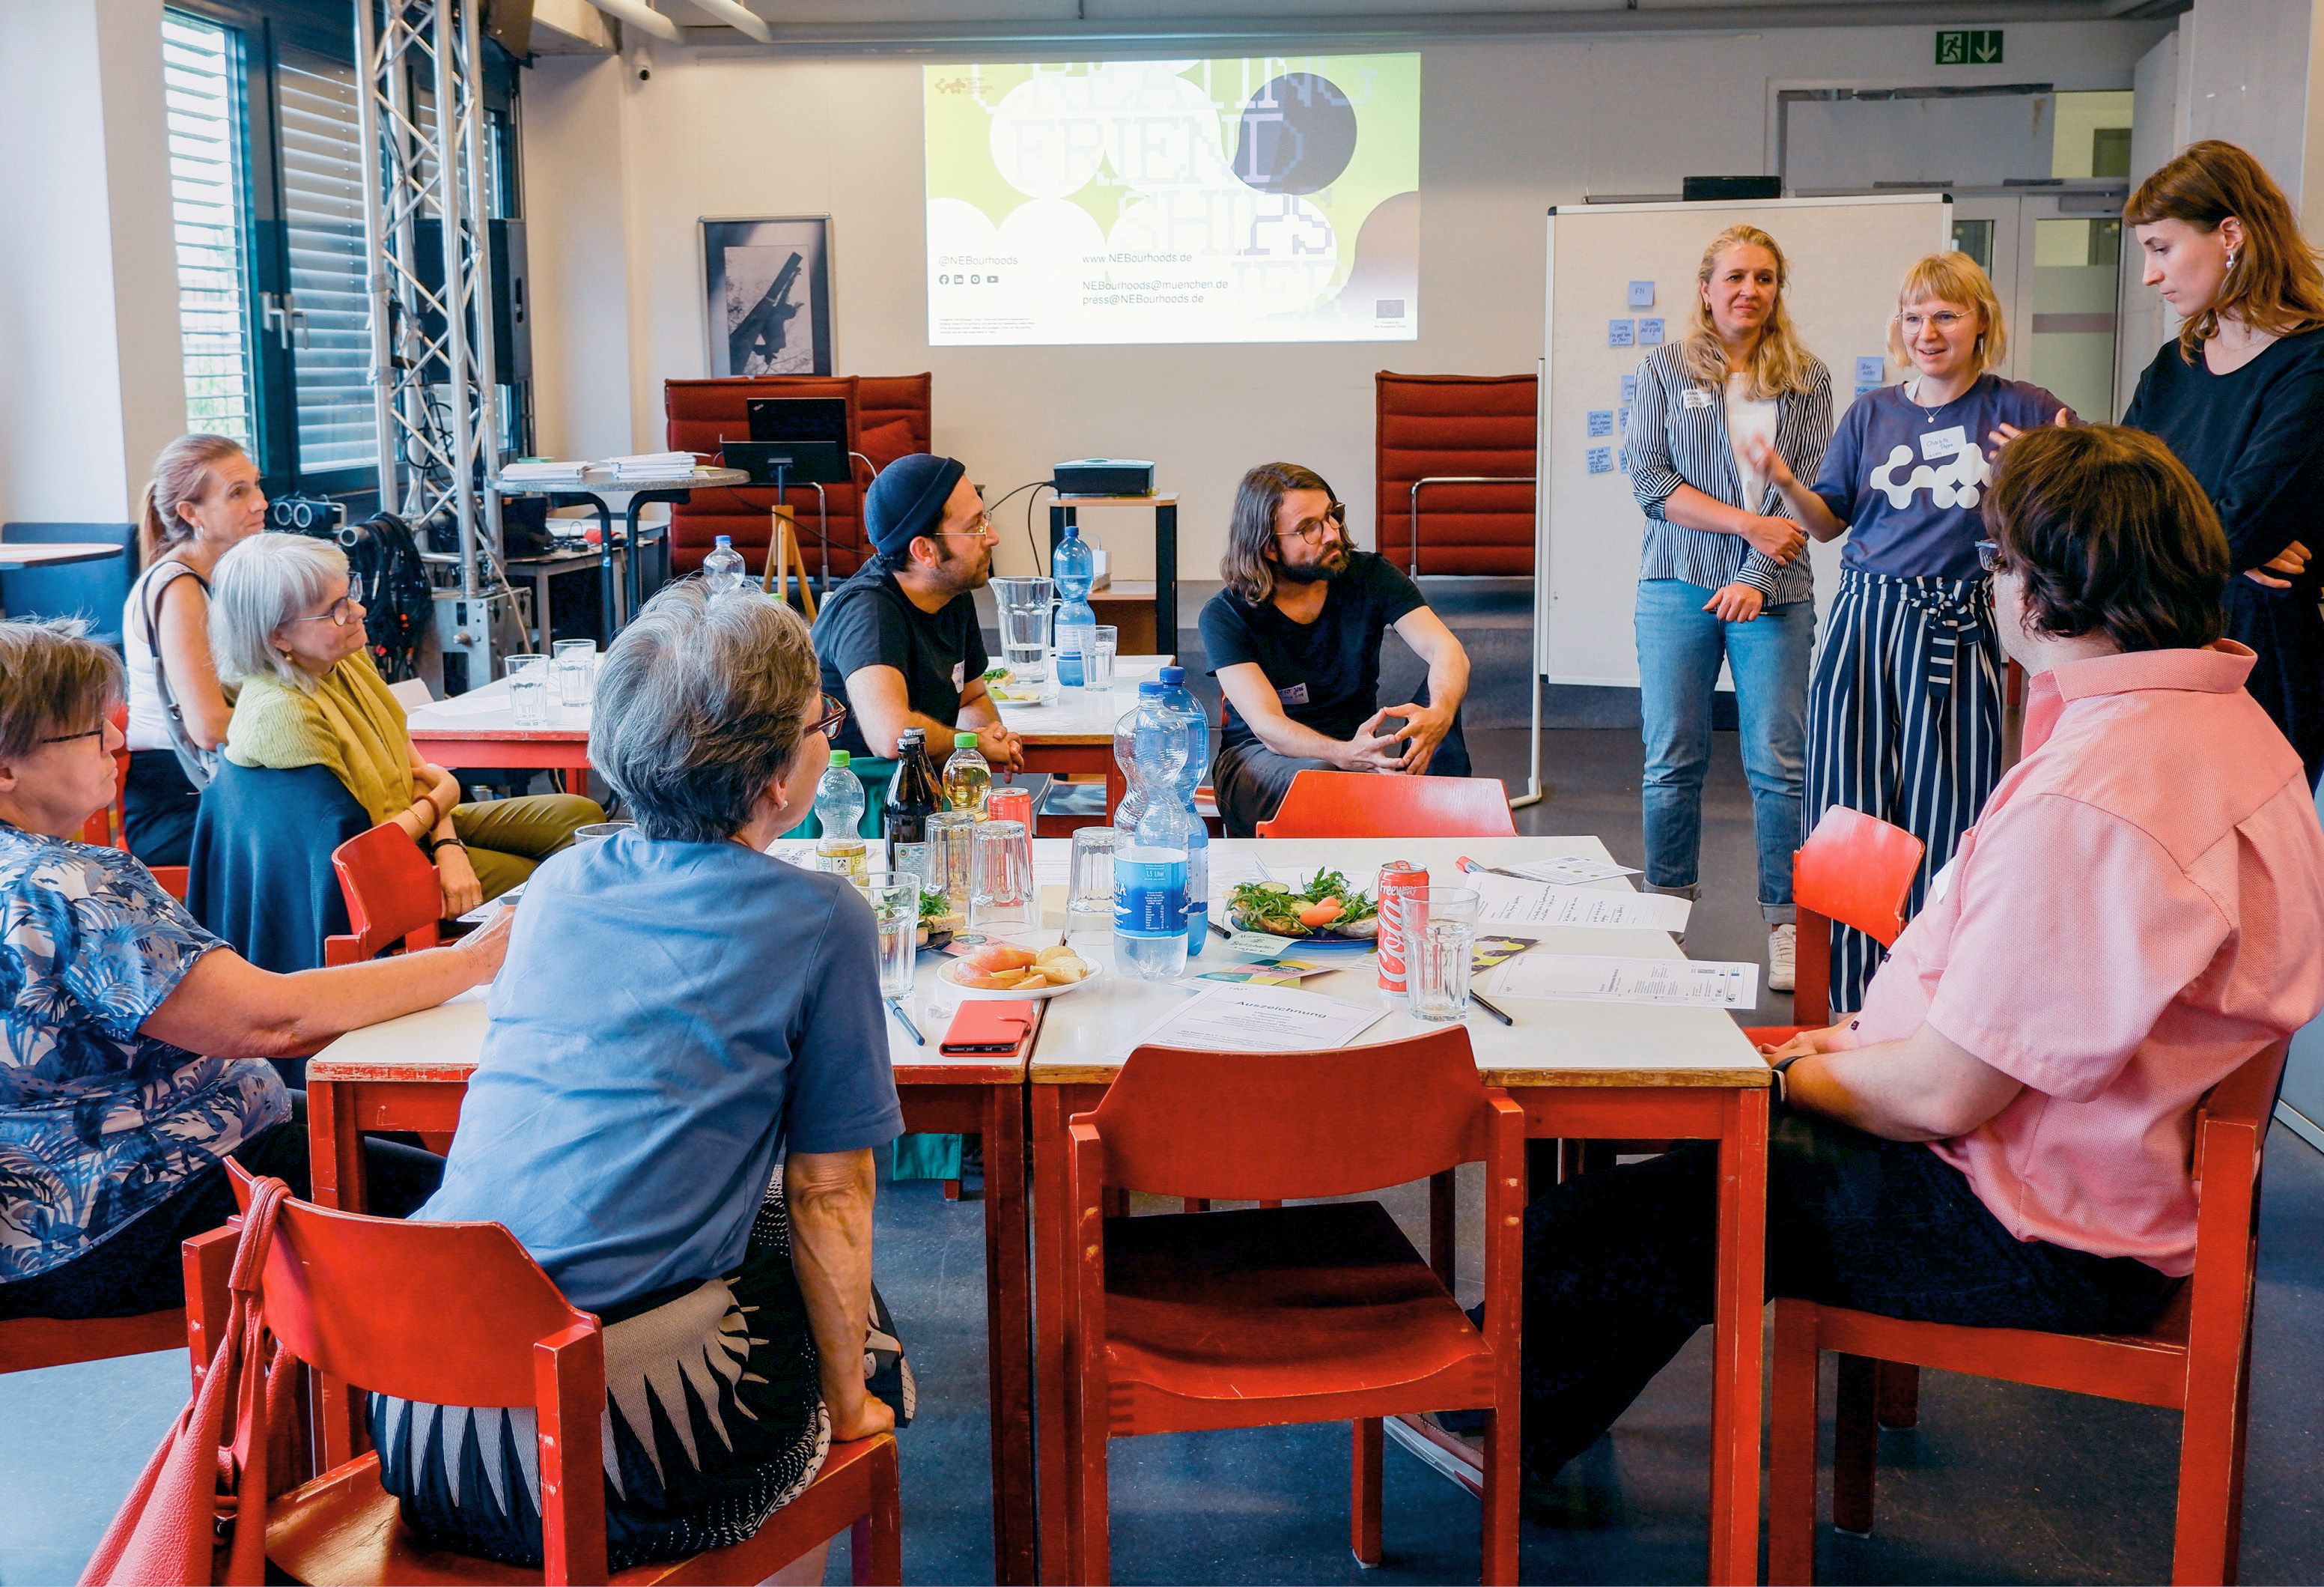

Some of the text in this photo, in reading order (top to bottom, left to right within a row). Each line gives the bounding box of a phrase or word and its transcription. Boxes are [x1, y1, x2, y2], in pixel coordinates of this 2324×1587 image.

[1010, 113, 1305, 186] FRIEND
[939, 255, 1019, 267] @NEBourhoods
[1083, 253, 1193, 263] www.NEBourhoods.de
[1083, 280, 1229, 291] NEBourhoods@muenchen.de
[1083, 294, 1205, 306] press@NEBourhoods.de
[1379, 881, 1417, 896] Freeway
[1235, 1001, 1327, 1019] Auszeichnung
